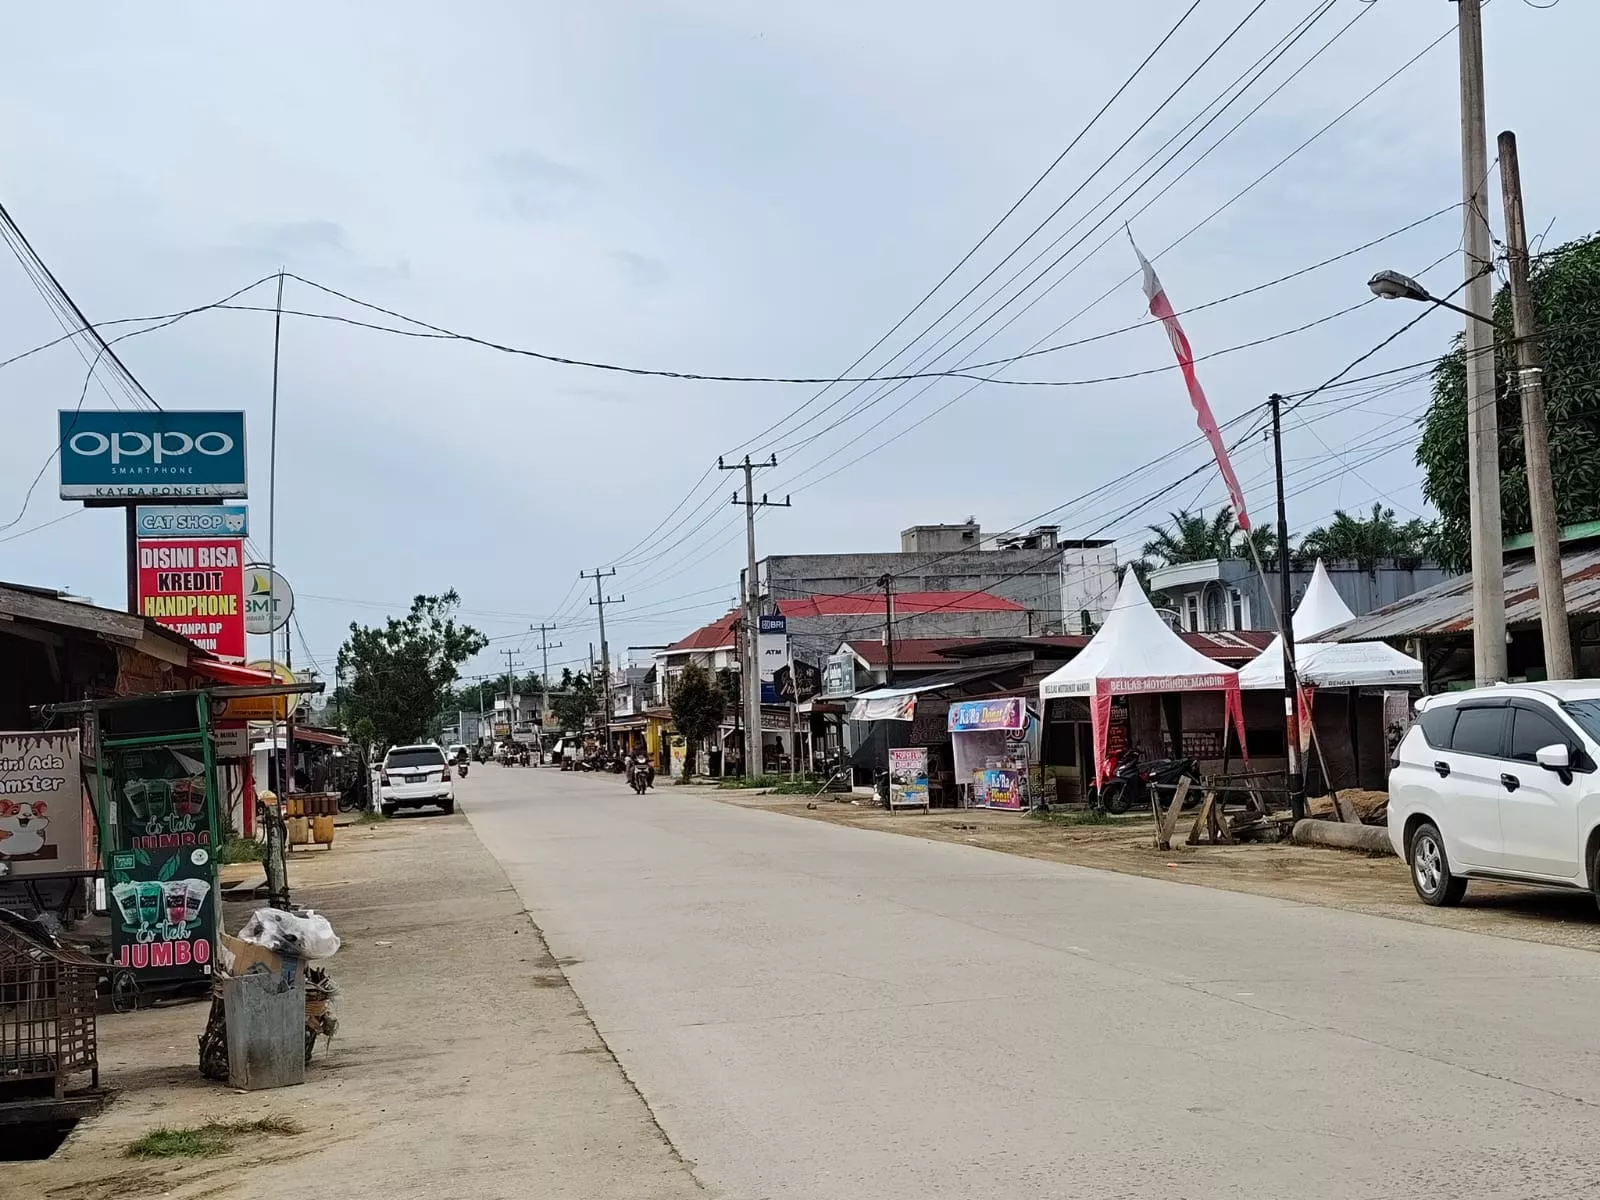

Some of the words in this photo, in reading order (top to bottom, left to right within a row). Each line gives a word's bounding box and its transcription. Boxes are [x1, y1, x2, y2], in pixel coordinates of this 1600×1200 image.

[69, 431, 234, 465] oppo
[111, 466, 193, 475] SMARTPHONE
[96, 487, 145, 497] KAYRA
[151, 487, 210, 497] PONSEL
[142, 515, 174, 530] CAT
[177, 514, 223, 530] SHOP
[140, 547, 194, 569] DISINI
[197, 547, 239, 568] BISA
[157, 571, 223, 593] KREDIT
[144, 594, 238, 618] HANDPHONE
[208, 622, 223, 635] DP
[770, 620, 784, 629] BRI
[1143, 678, 1189, 690] MOTORINDO
[1191, 675, 1225, 688] MANDIRI
[28, 754, 65, 771] Ada
[145, 814, 164, 835] Es
[135, 921, 156, 944] Es
[113, 938, 210, 968] JUMBO
